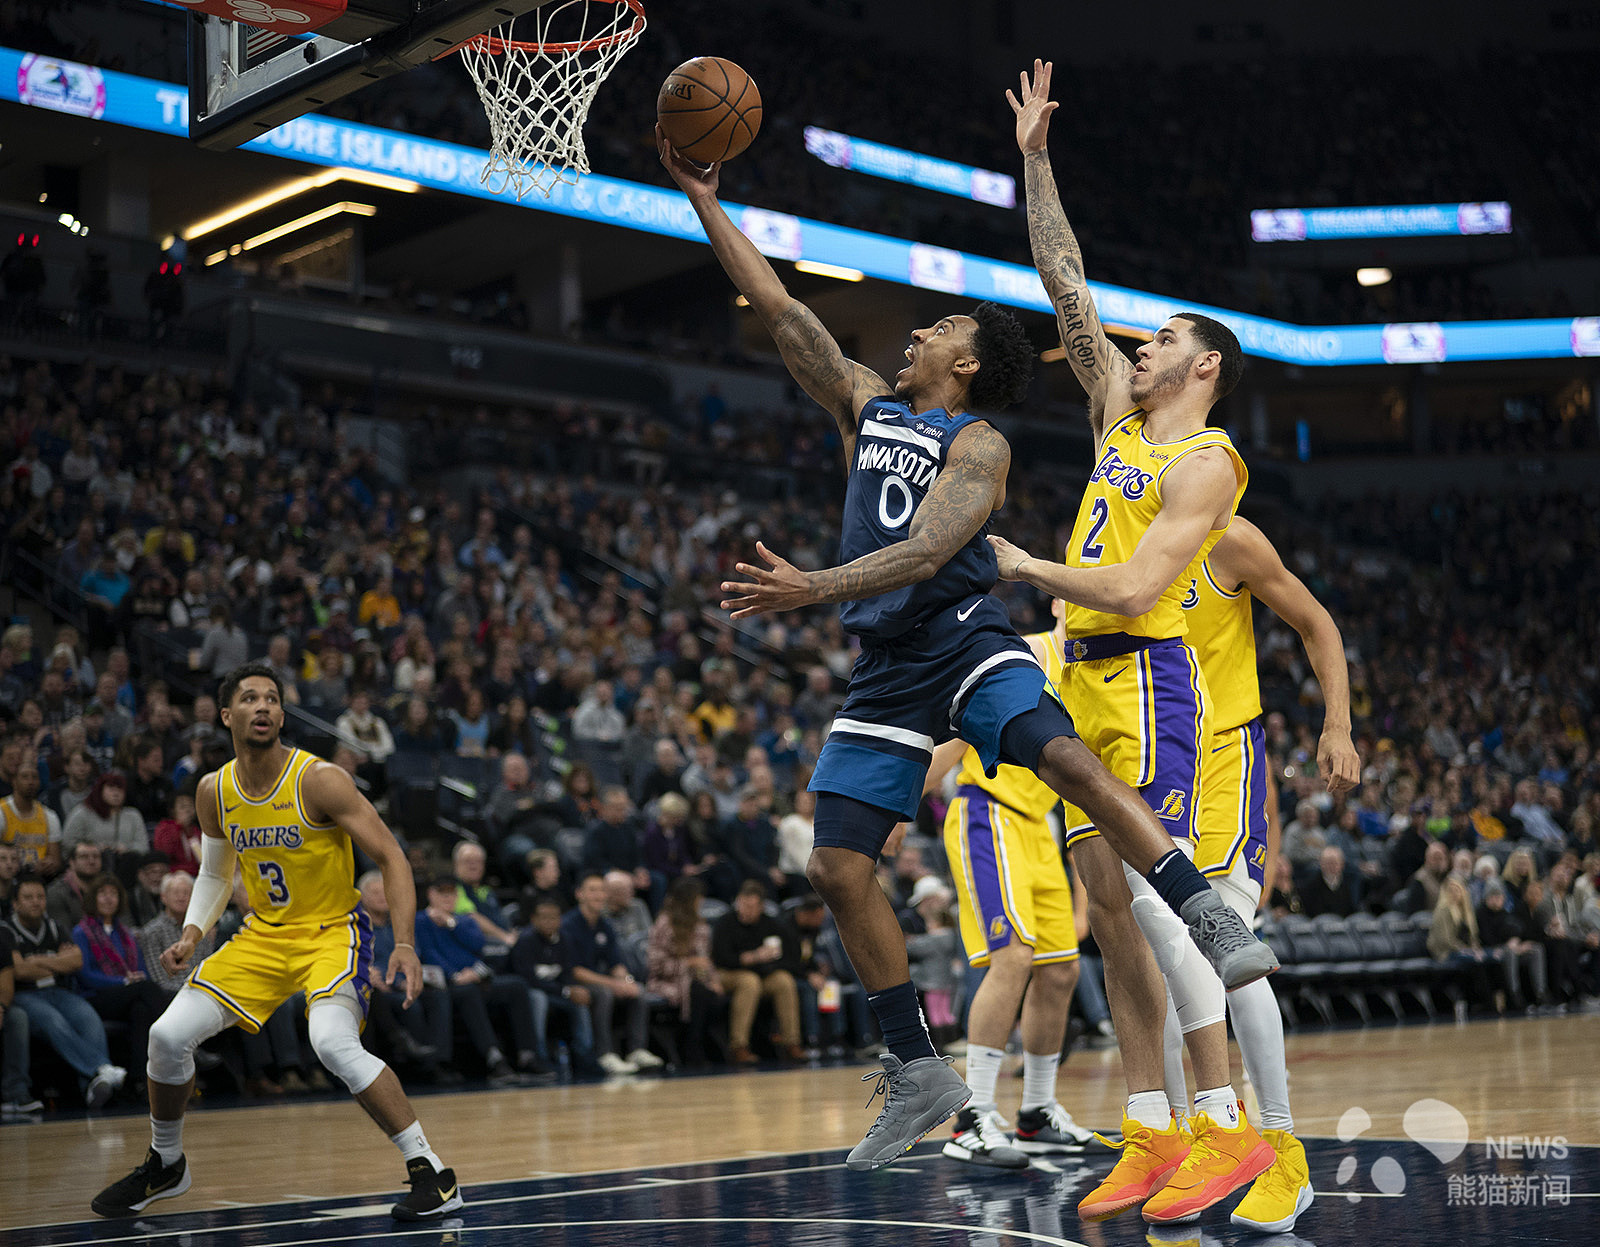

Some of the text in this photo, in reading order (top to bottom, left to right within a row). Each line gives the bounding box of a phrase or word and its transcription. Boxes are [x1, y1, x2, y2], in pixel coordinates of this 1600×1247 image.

[341, 129, 459, 182] ISLAND
[597, 184, 701, 234] CASINO
[1057, 290, 1096, 369] FEAR GOD
[878, 474, 914, 529] 0
[1079, 497, 1109, 564] 2
[271, 801, 294, 811] wish
[228, 823, 304, 854] LAKERS
[257, 861, 292, 907] 3
